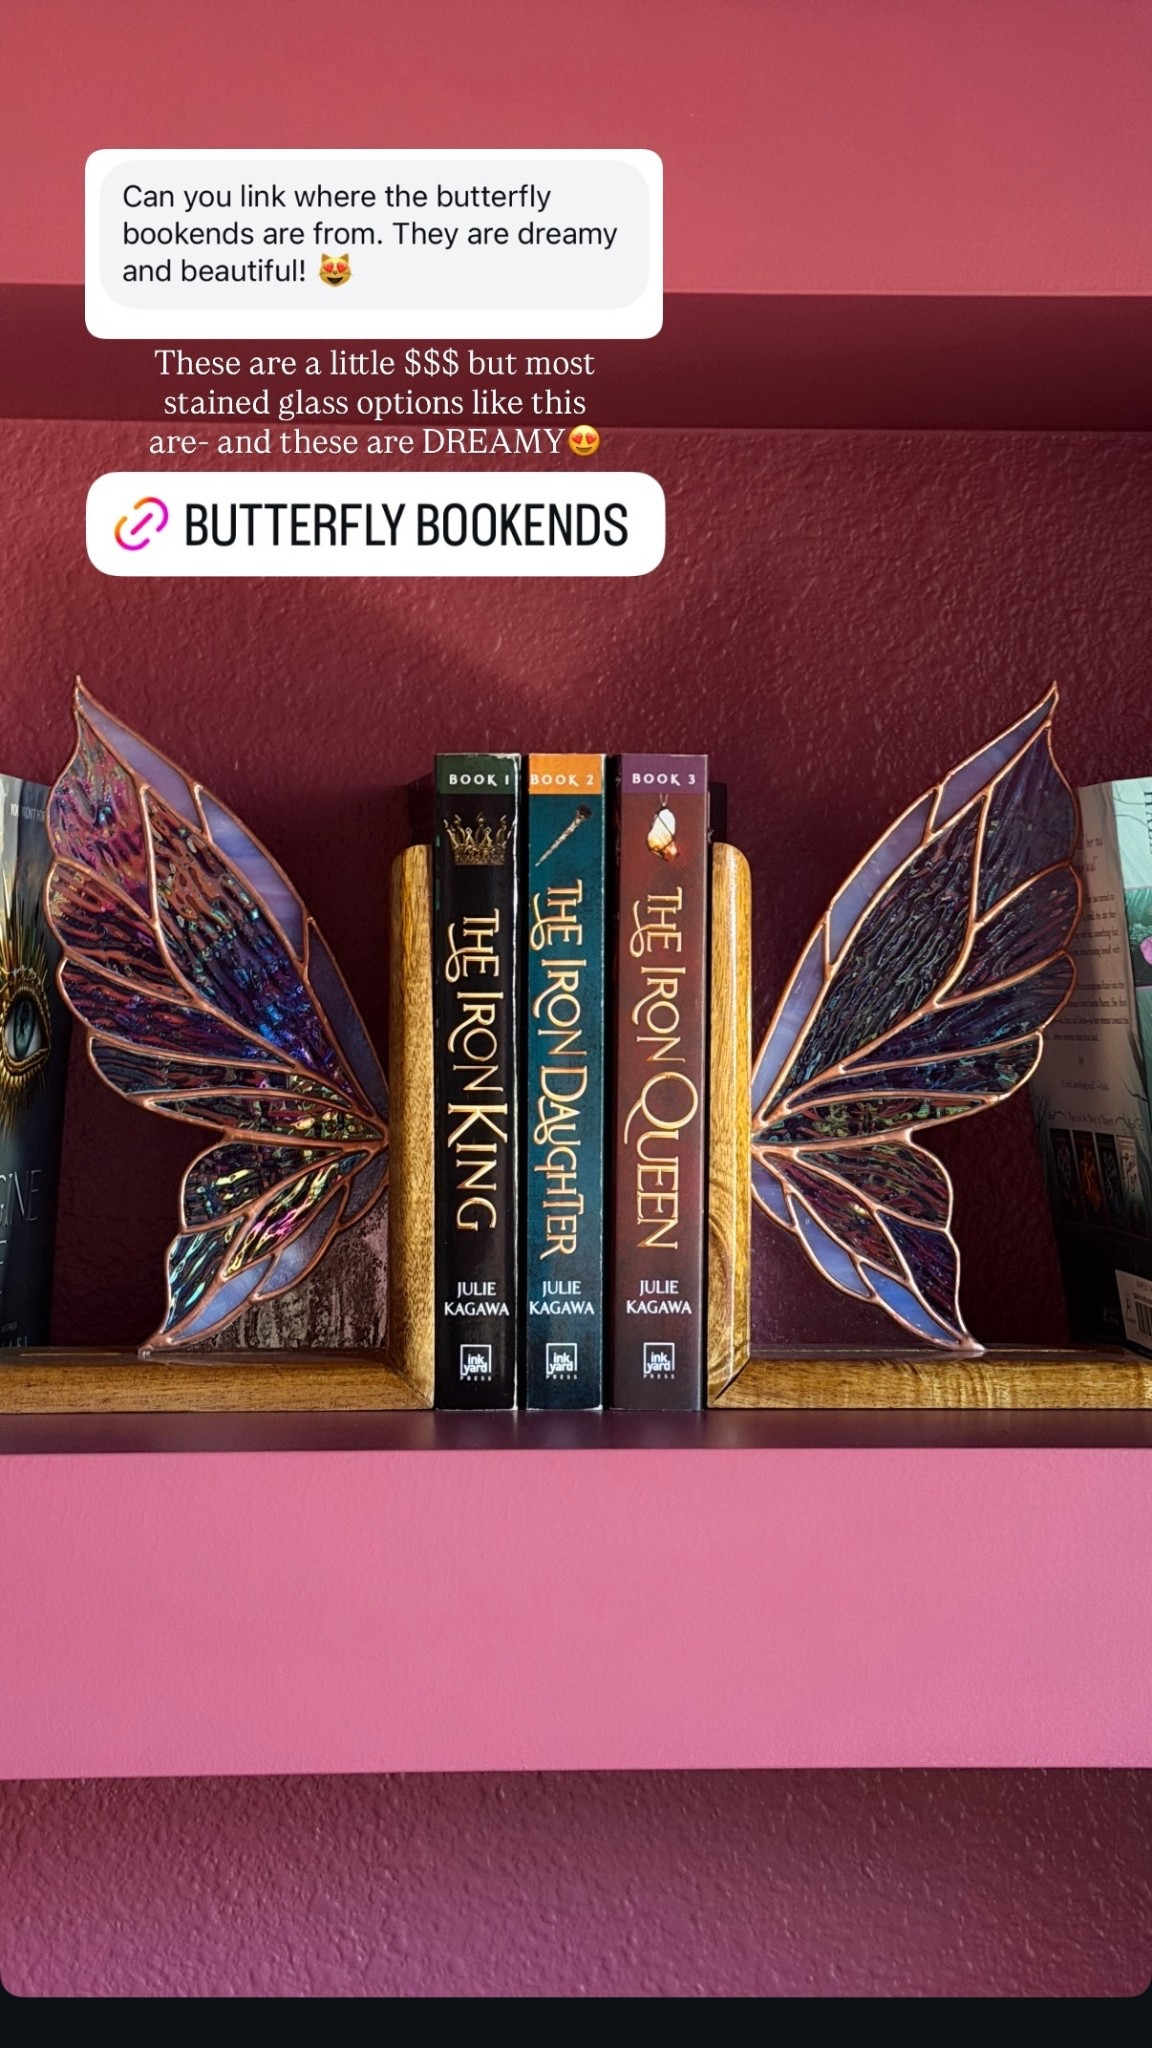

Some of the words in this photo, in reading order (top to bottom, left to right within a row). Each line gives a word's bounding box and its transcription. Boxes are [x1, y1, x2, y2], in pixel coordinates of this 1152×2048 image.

[449, 773, 498, 787] BOOK
[504, 774, 510, 786] 1
[530, 773, 580, 787] BOOK
[586, 774, 594, 786] 2
[632, 772, 681, 787] BOOK
[688, 773, 696, 786] 3
[529, 878, 584, 951] THE
[629, 886, 683, 957] THE
[444, 907, 500, 983] THE
[532, 958, 588, 1055] IRON
[631, 966, 686, 1062] IRON
[447, 991, 504, 1092] IRON
[447, 1102, 509, 1232] KING
[533, 1065, 588, 1260] DAUGHTER
[623, 1071, 699, 1250] QUEEN
[457, 1281, 497, 1298] JULIE
[542, 1280, 582, 1298] JULIE
[639, 1279, 679, 1297] JULIE
[444, 1301, 510, 1316] KAGAWA
[529, 1300, 595, 1315] KAGAWA
[626, 1299, 692, 1315] KAGAWA
[467, 1353, 485, 1365] ink
[553, 1352, 570, 1364] ink
[650, 1352, 668, 1363] ink
[463, 1361, 488, 1375] yard
[550, 1360, 573, 1374] yard
[647, 1359, 671, 1373] yard
